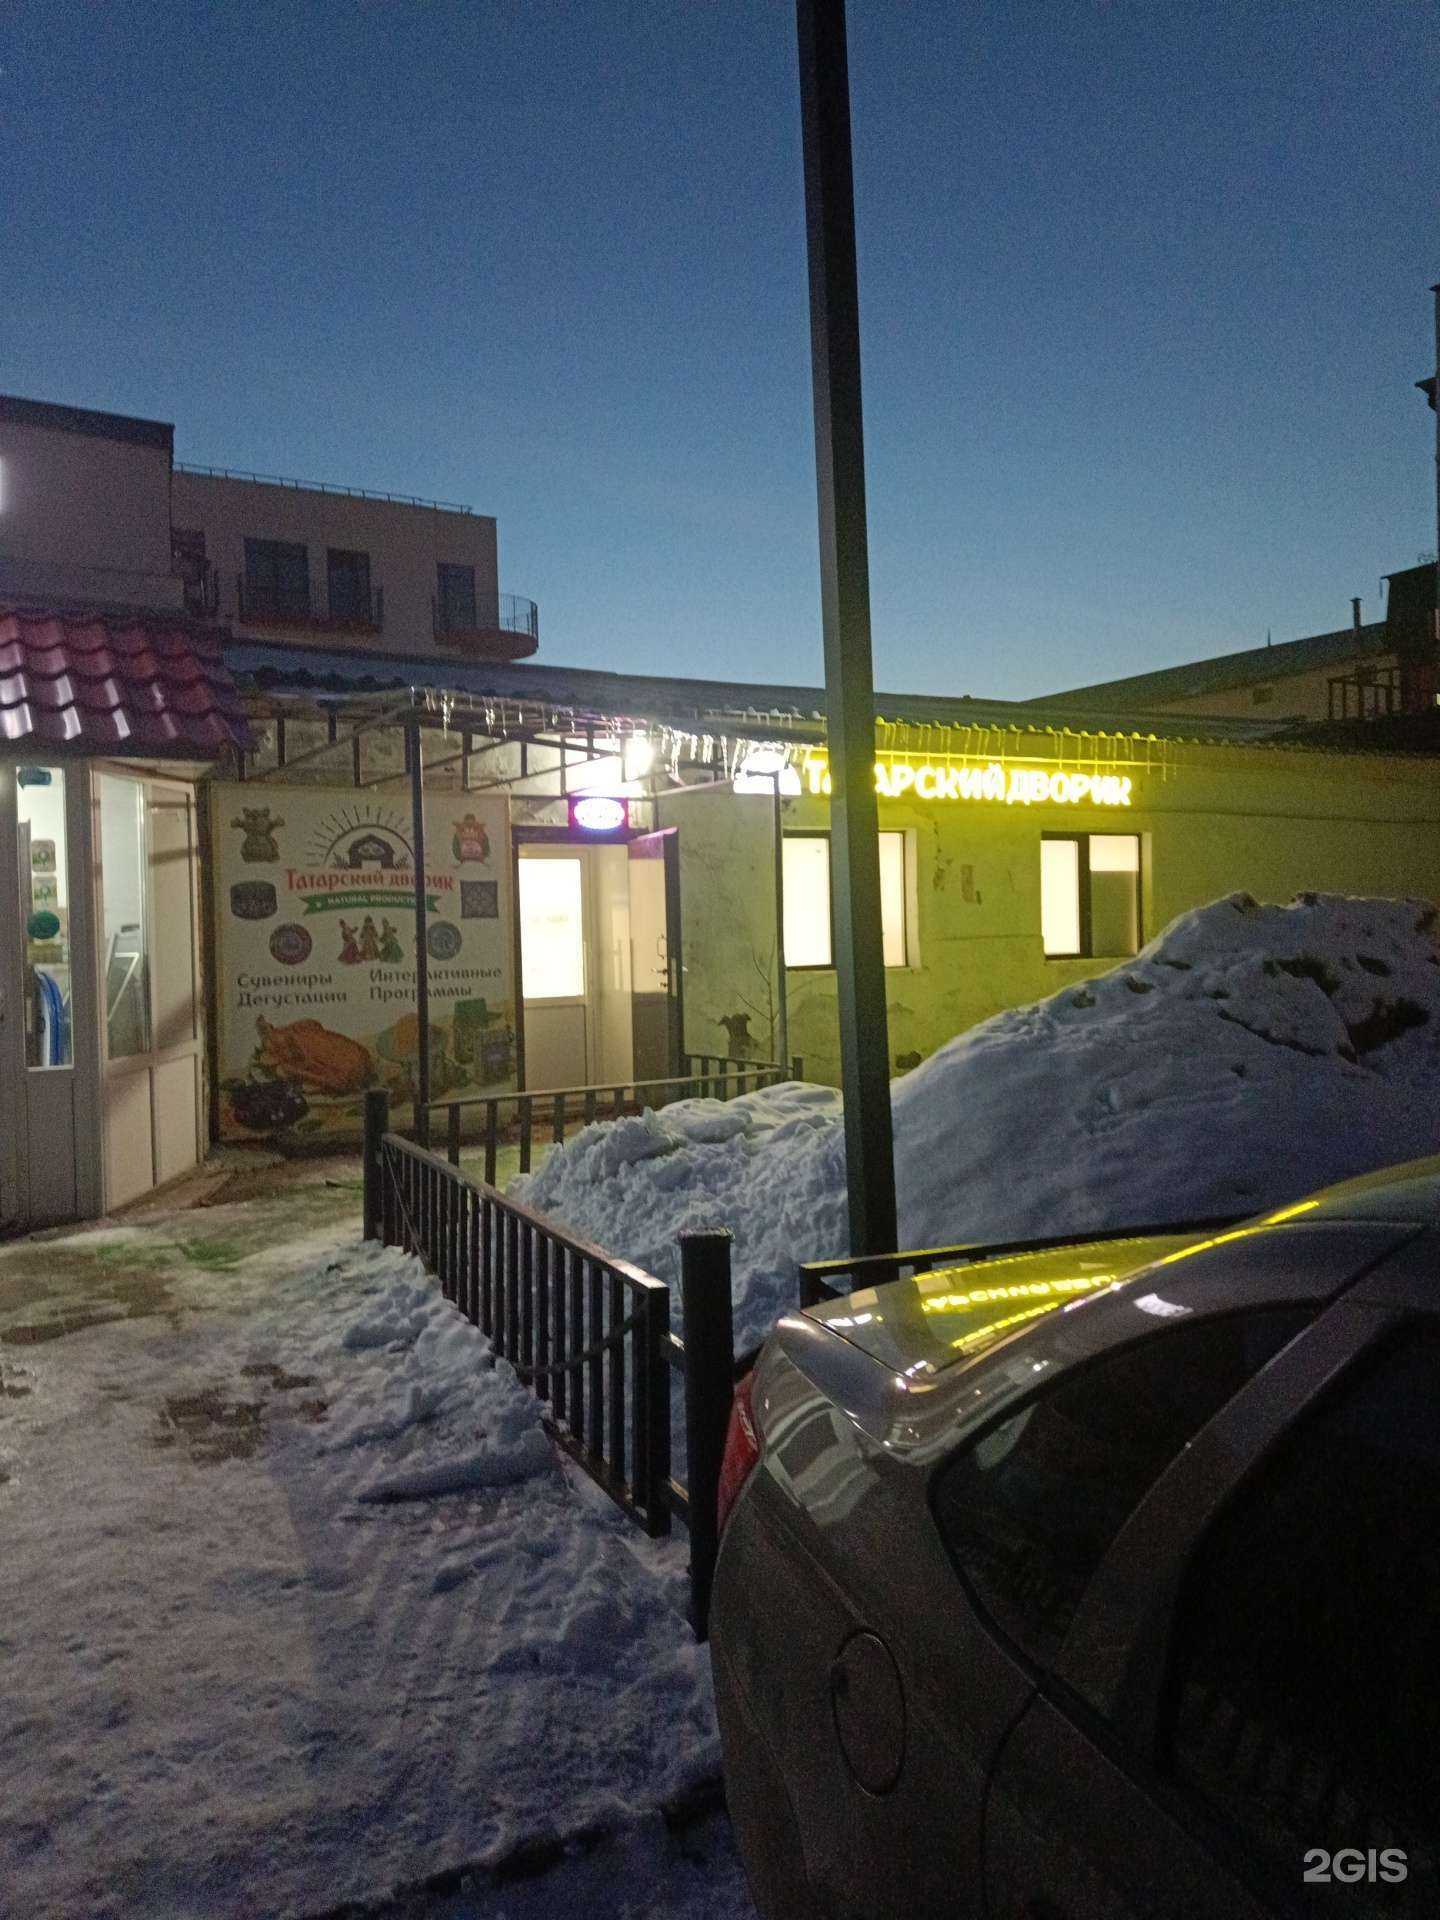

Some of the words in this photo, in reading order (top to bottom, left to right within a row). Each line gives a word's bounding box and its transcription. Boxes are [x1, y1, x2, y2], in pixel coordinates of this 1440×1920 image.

[805, 758, 1005, 800] ТАРСКИЙ
[1006, 768, 1132, 805] ДВОРИК
[286, 868, 383, 890] Татарский
[237, 973, 332, 989] Сувениры
[238, 992, 347, 1008] Дегустации
